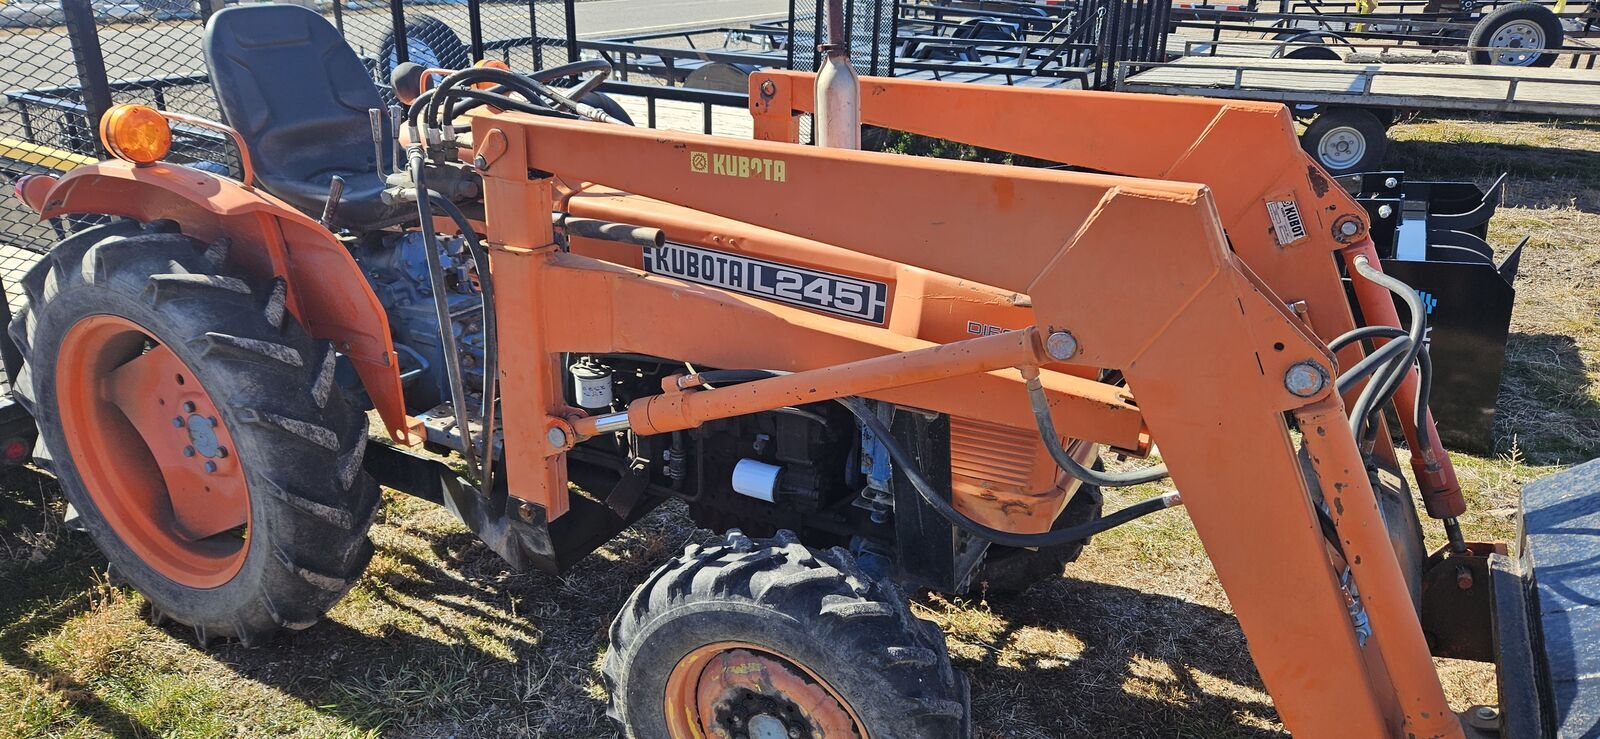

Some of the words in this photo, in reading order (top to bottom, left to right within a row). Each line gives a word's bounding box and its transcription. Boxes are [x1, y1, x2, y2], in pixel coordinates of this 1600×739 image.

[713, 153, 785, 182] KUBOTA
[1284, 206, 1304, 237] KUBOT
[656, 247, 742, 288] KUBOTA
[752, 265, 864, 313] L245
[967, 320, 1011, 336] DIE
